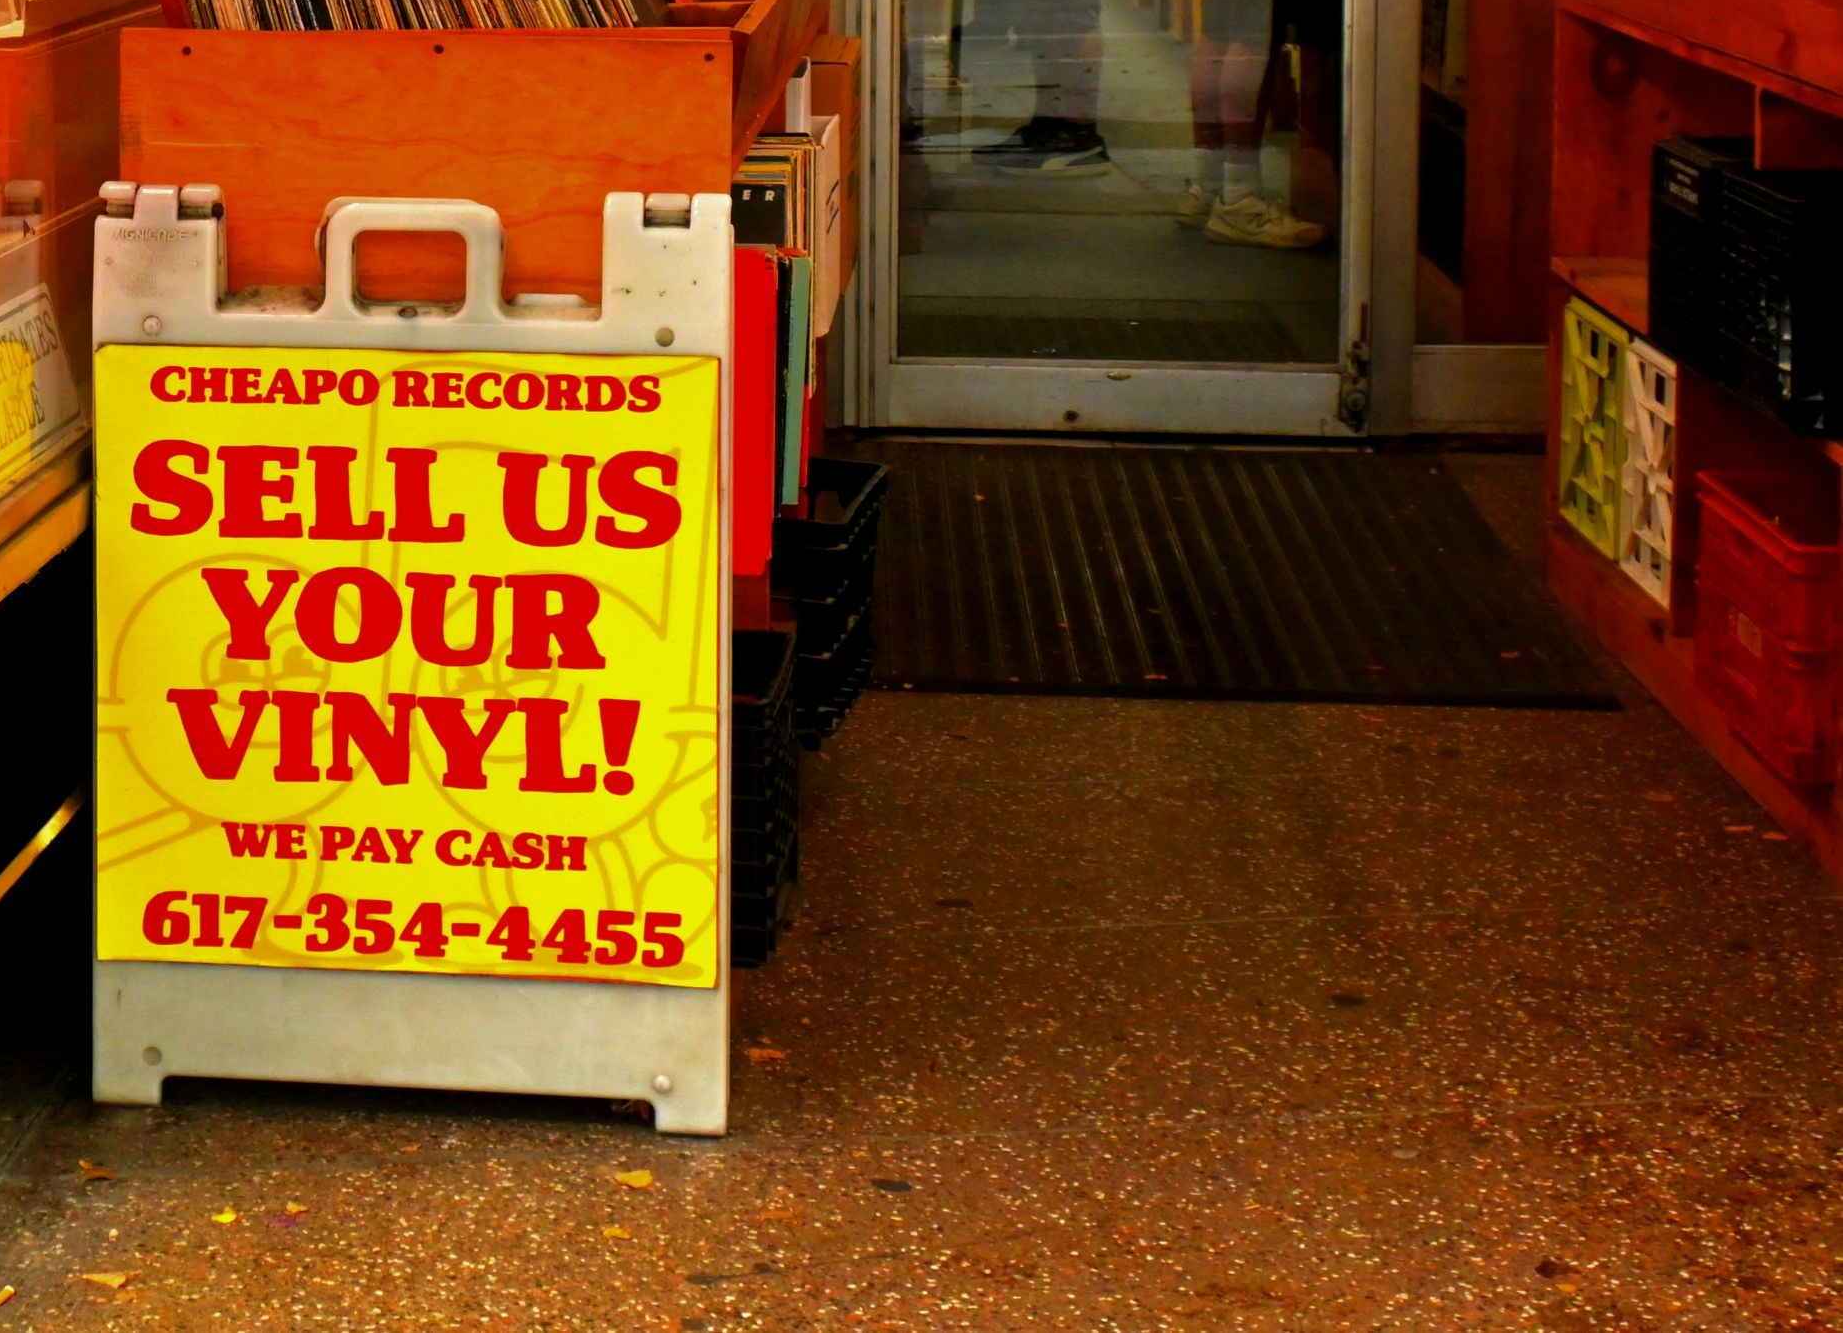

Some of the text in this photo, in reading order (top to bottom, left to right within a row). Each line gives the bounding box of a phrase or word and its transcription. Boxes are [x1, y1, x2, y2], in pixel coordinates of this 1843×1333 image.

[149, 365, 661, 413] CHEAPO RECORDS
[131, 439, 682, 549] SELL US
[201, 566, 606, 671] YOUR
[167, 688, 641, 796] VINYL!
[222, 821, 588, 871] WE PAY CASH
[142, 890, 685, 968] 617-354-4455
